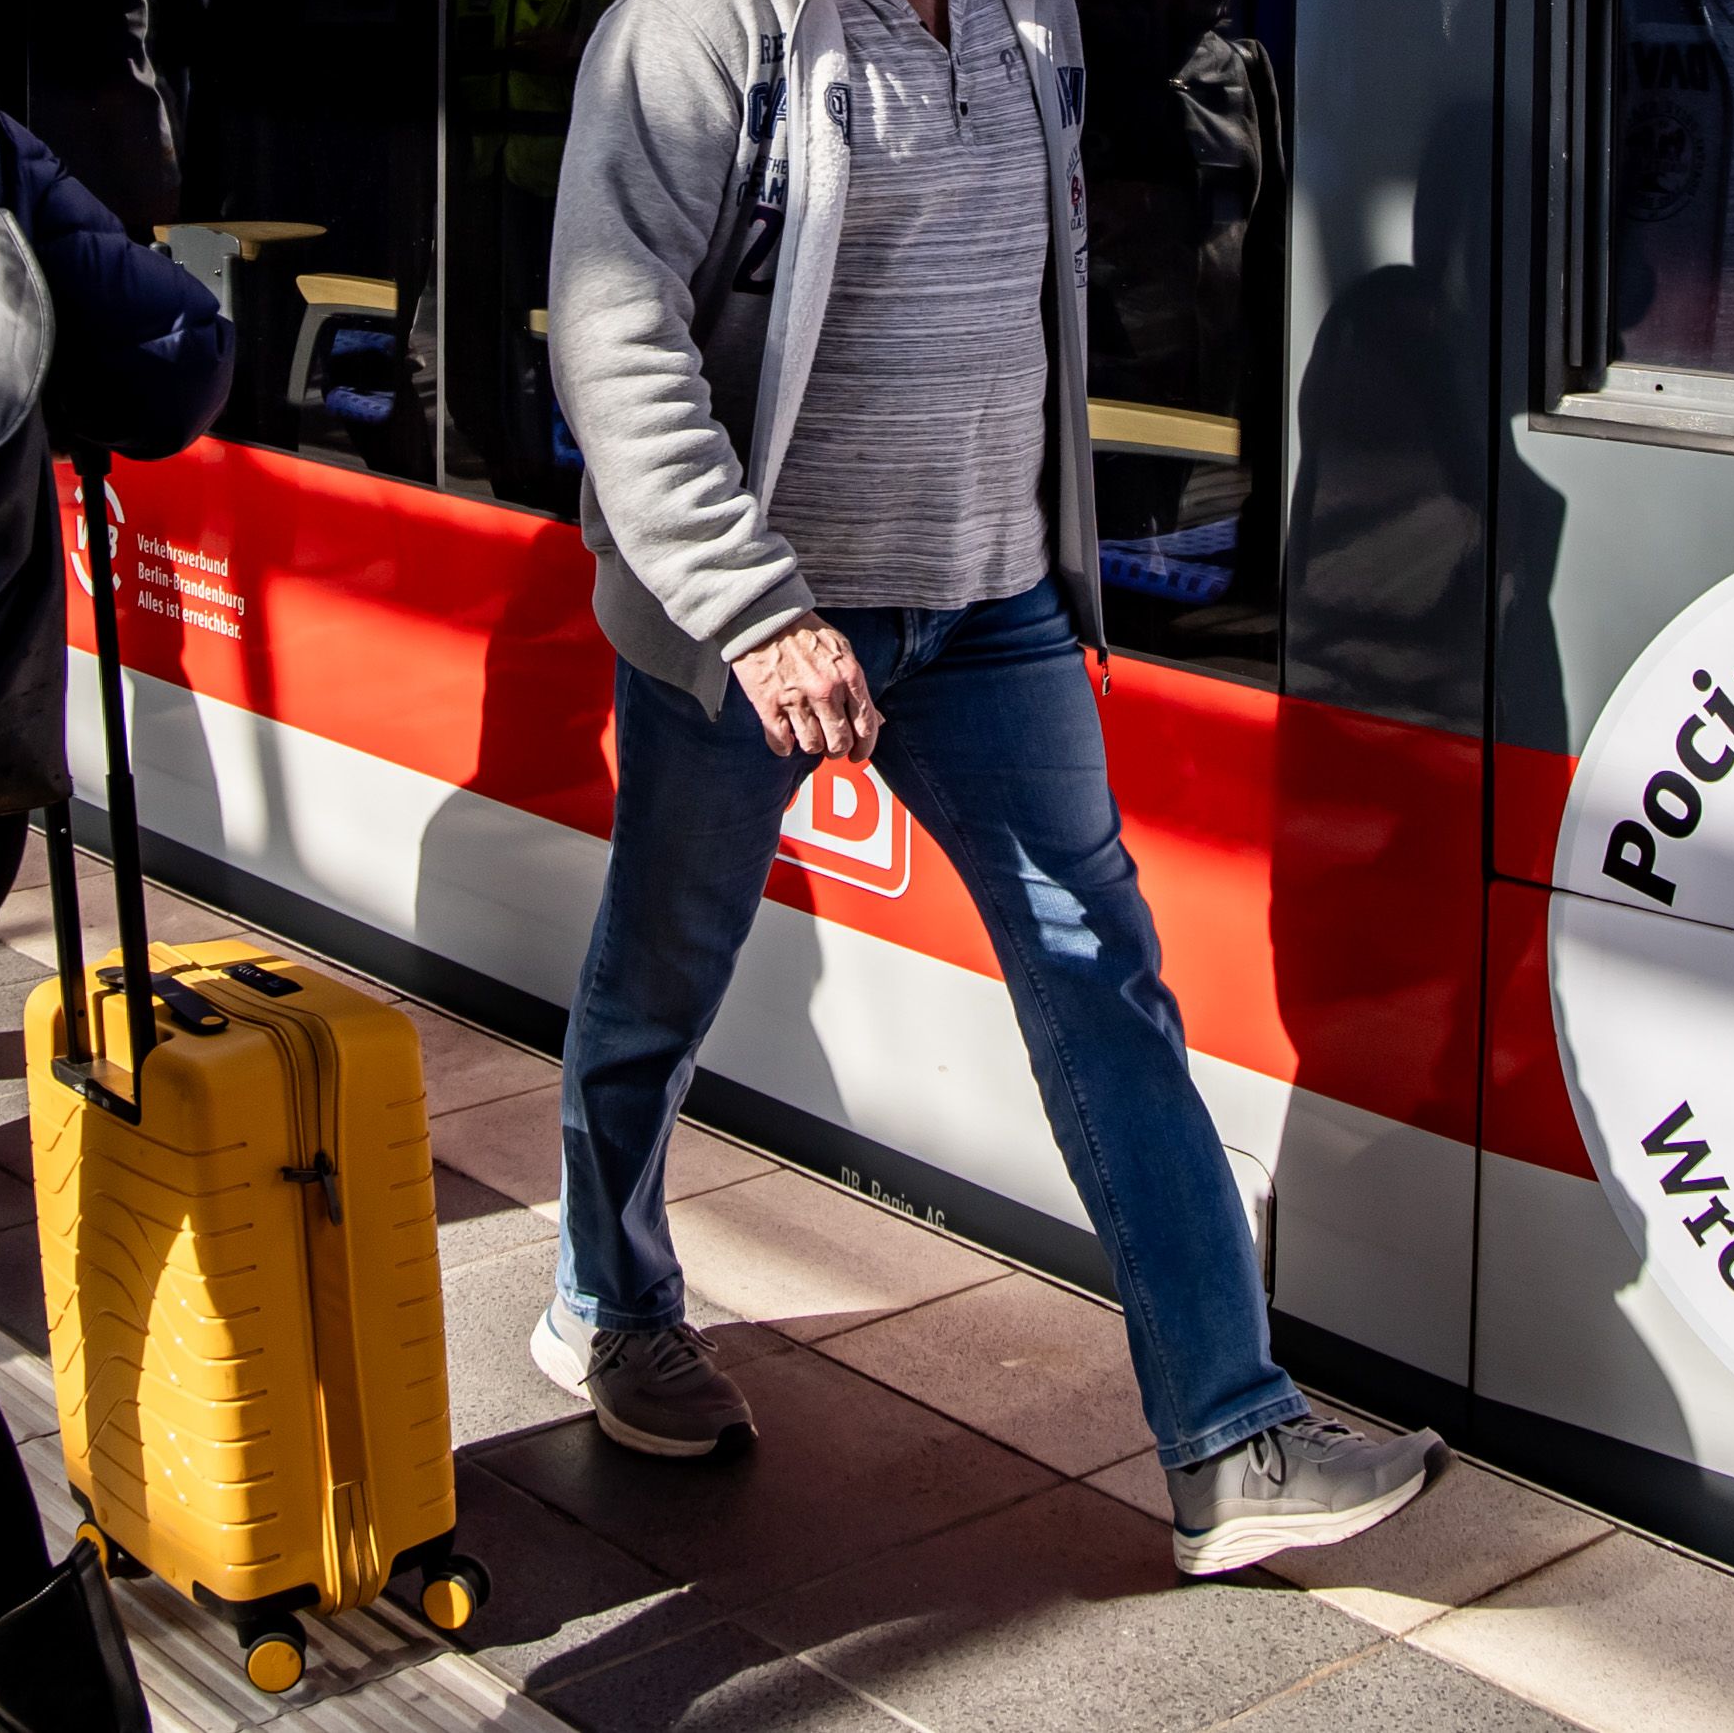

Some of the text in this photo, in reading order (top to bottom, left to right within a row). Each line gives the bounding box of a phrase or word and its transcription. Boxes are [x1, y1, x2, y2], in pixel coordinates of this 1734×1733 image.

[137, 533, 229, 577] Verkehrsverbund
[137, 562, 245, 616] Berlin-Brandenburg
[137, 590, 242, 640] Alles ist erreichbar.
